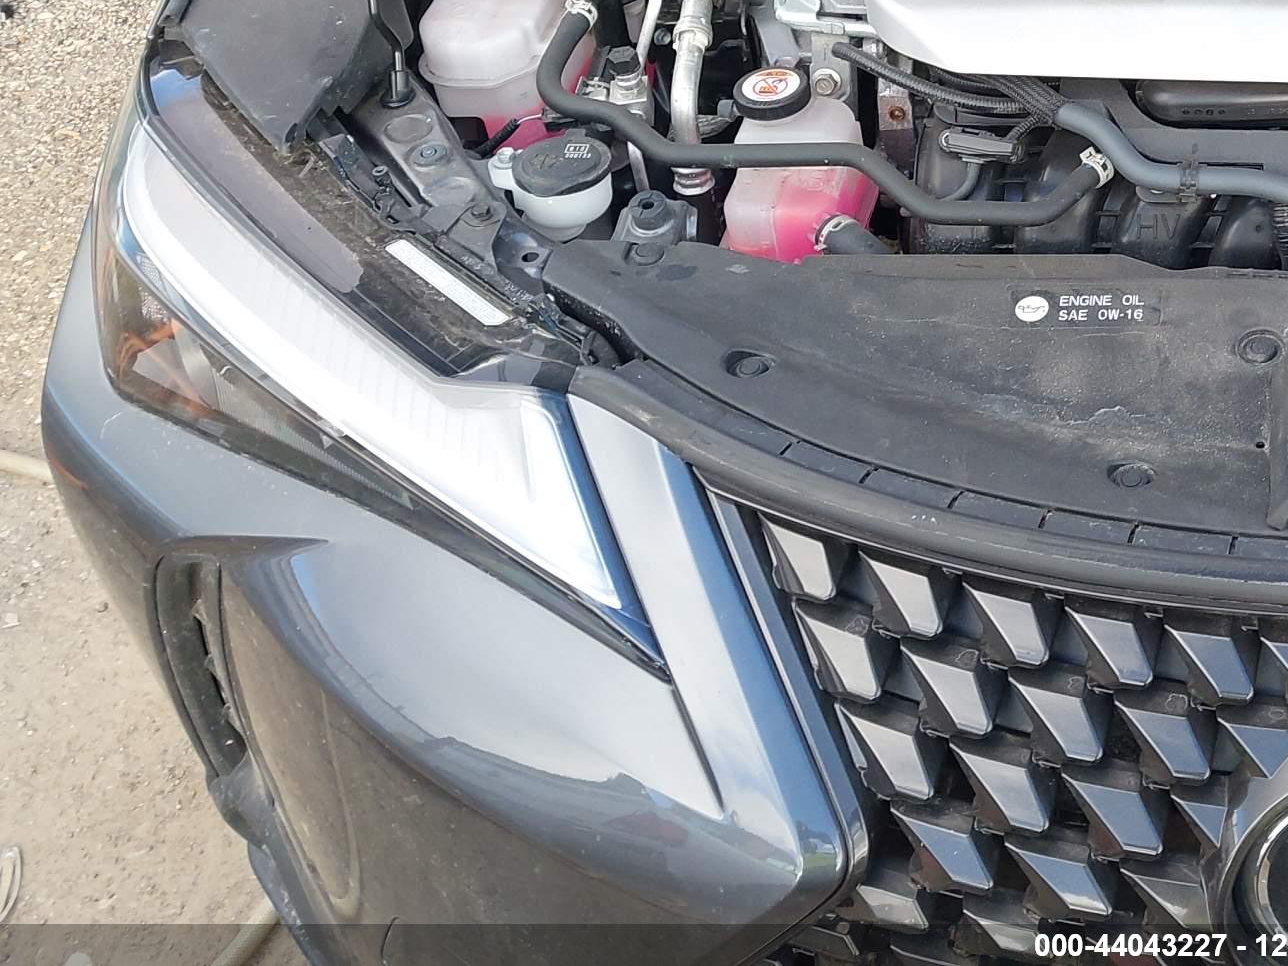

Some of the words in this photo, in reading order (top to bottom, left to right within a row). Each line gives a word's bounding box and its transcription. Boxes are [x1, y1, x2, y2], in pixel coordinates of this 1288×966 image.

[1136, 213, 1181, 241] HV
[1059, 295, 1112, 306] ENGINE
[1121, 294, 1145, 306] OIL
[1058, 309, 1089, 321] SAE
[1097, 308, 1144, 321] 0W-16
